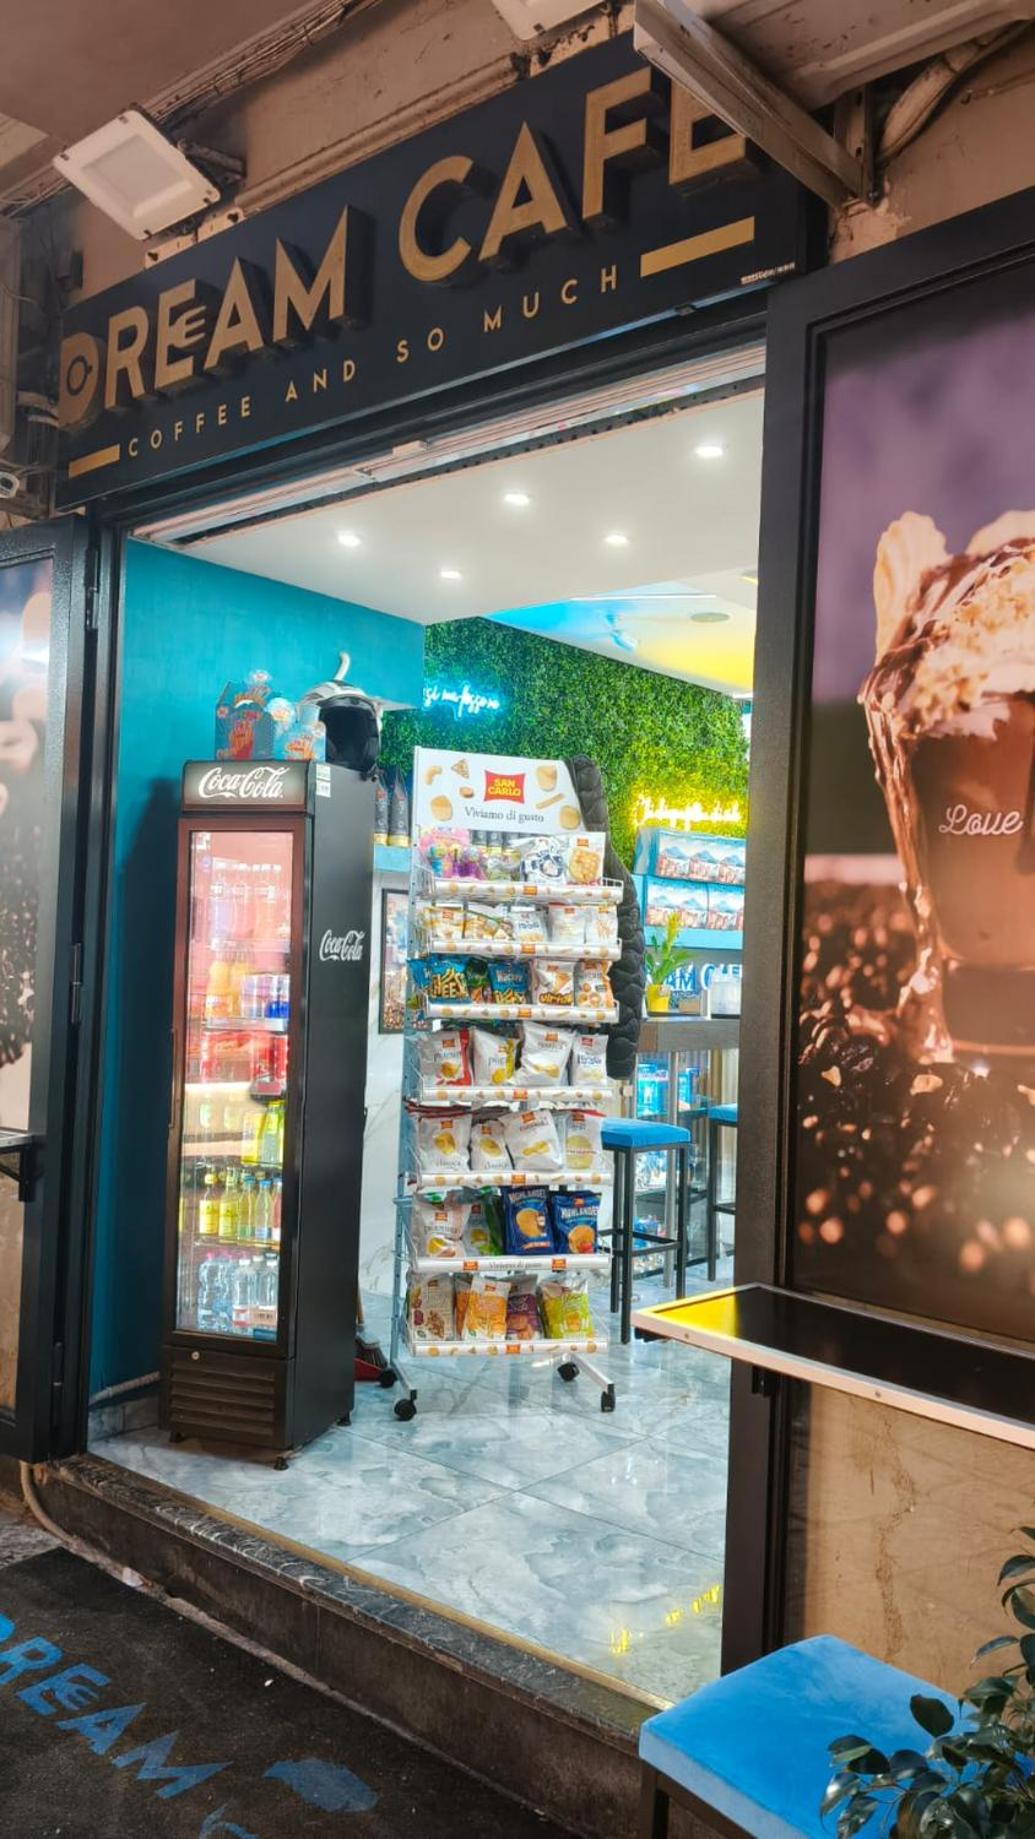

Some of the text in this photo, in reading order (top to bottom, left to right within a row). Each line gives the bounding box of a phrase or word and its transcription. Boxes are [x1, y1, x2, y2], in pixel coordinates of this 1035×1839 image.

[57, 204, 349, 428] DREAM
[128, 264, 618, 459] COFFEE AND SO MUCH
[199, 766, 291, 799] Coca-Cola
[488, 785, 521, 797] CARLO
[495, 778, 516, 788] SAN
[464, 806, 504, 820] Viviamo
[506, 808, 517, 821] di
